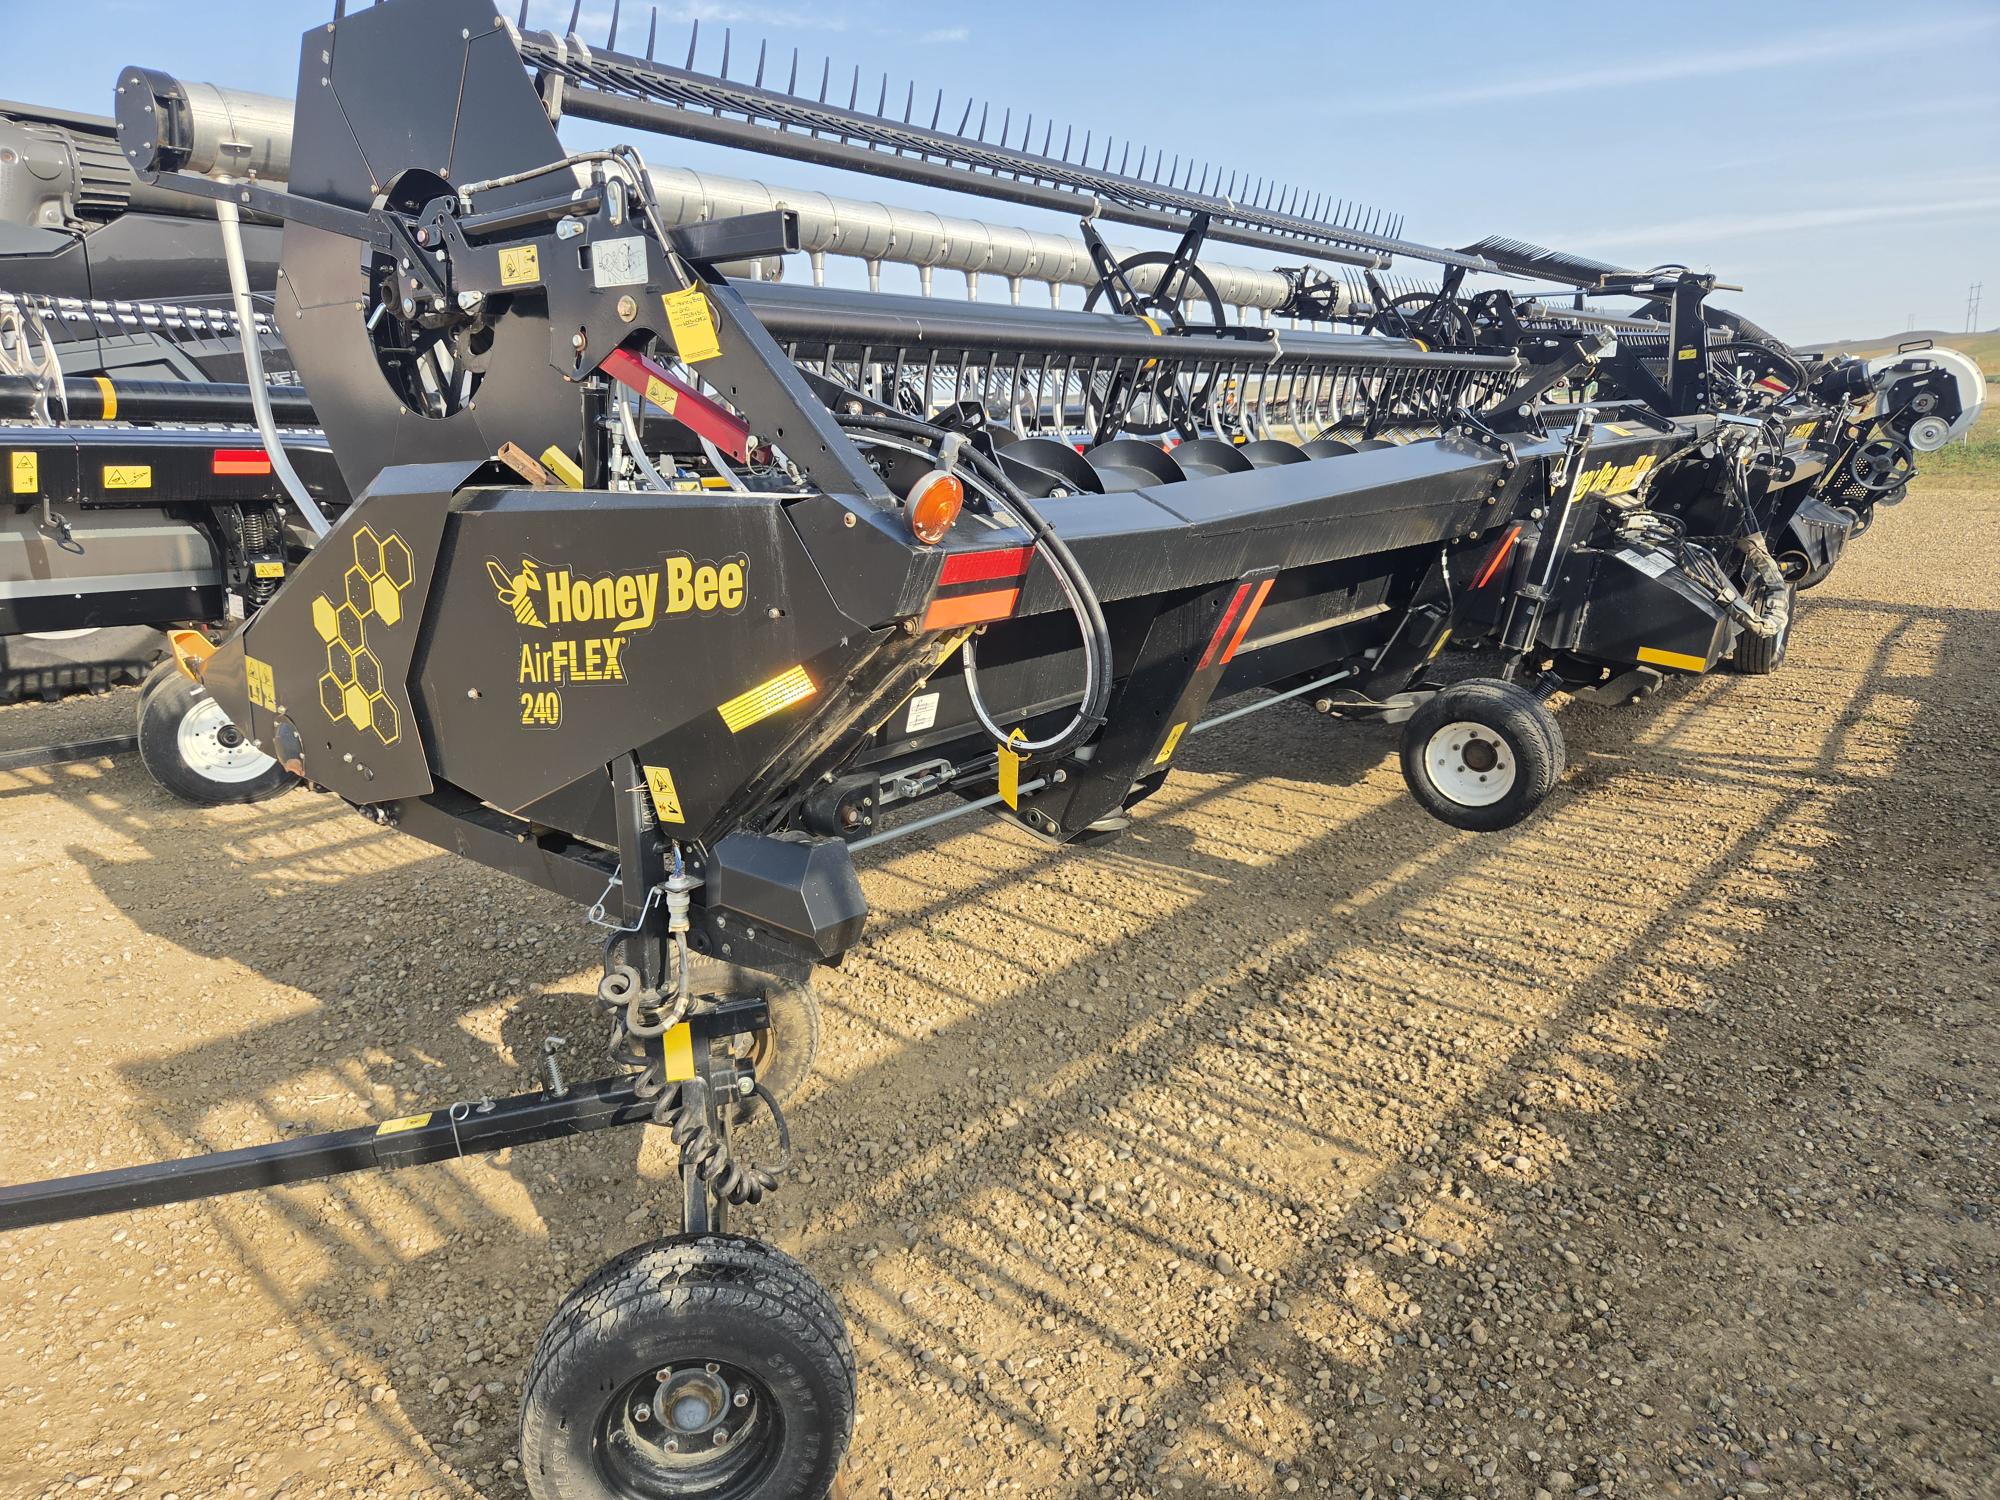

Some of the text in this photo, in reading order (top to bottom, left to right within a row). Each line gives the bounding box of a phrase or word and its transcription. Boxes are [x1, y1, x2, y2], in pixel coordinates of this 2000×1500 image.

[546, 557, 744, 632] Honey Bee
[520, 637, 624, 683] AirFLEX
[521, 692, 559, 725] 240
[767, 1352, 821, 1496] SPORT TRAIL
